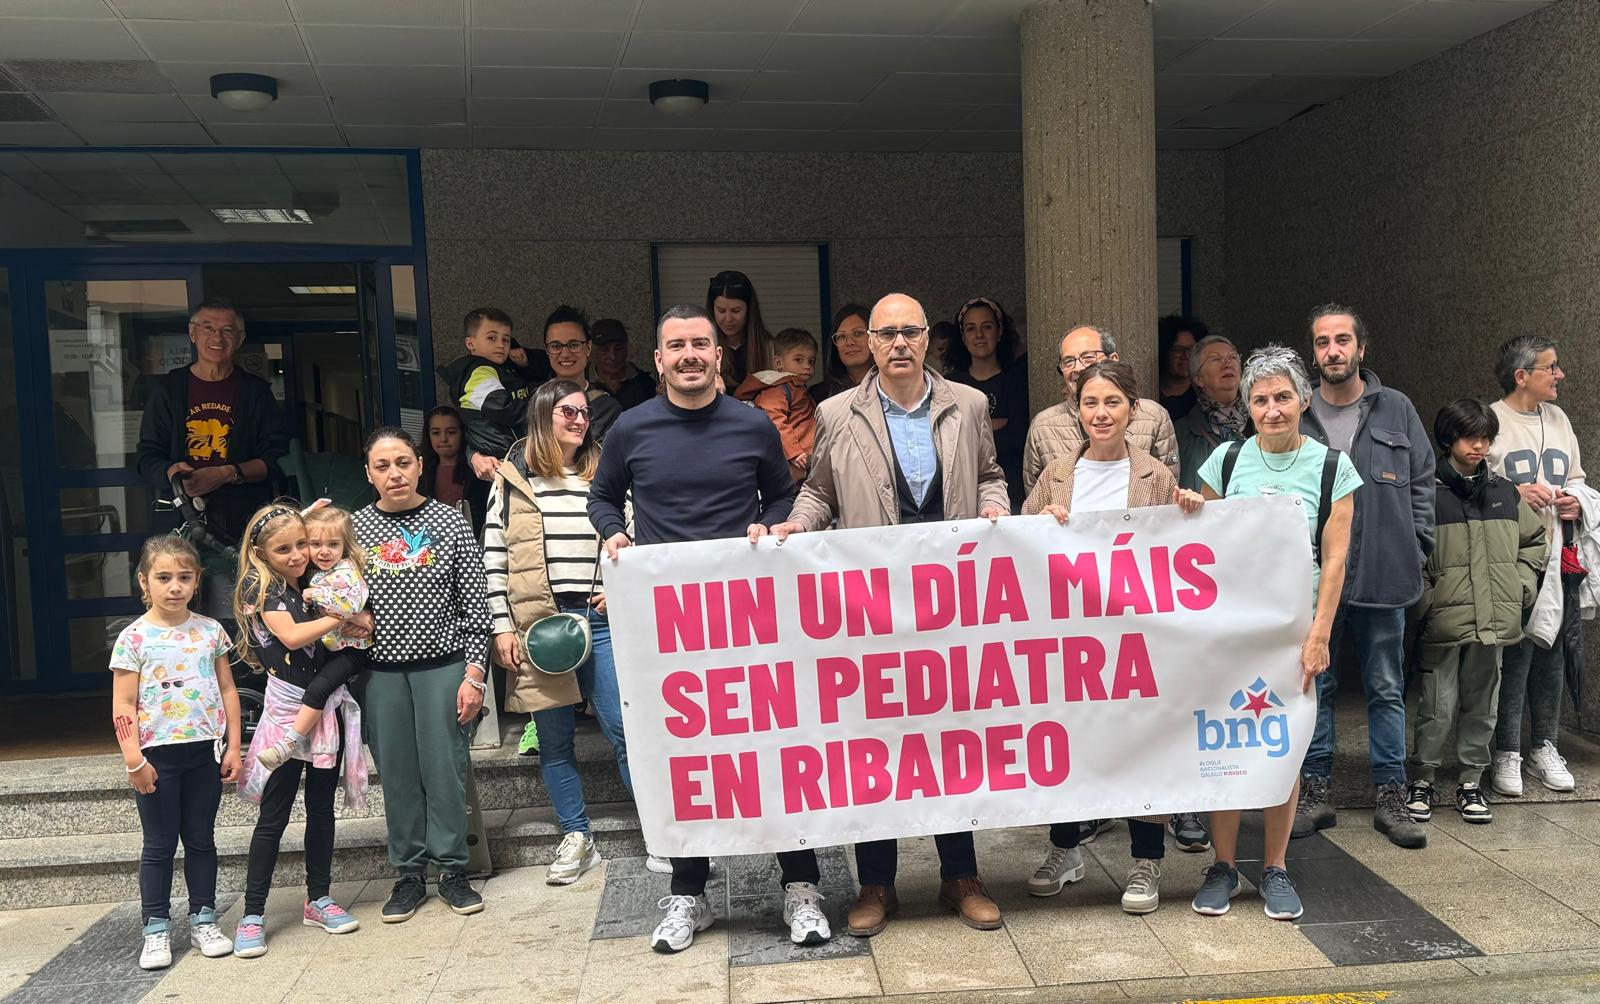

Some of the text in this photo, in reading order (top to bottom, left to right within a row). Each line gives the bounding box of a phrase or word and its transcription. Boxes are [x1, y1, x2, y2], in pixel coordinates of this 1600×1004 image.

[654, 533, 1218, 653] NIN UN DÍA MÁIS
[662, 633, 1159, 738] SEN PEDIATRA
[1193, 709, 1290, 758] bng
[670, 721, 1070, 821] EN RIBADEO
